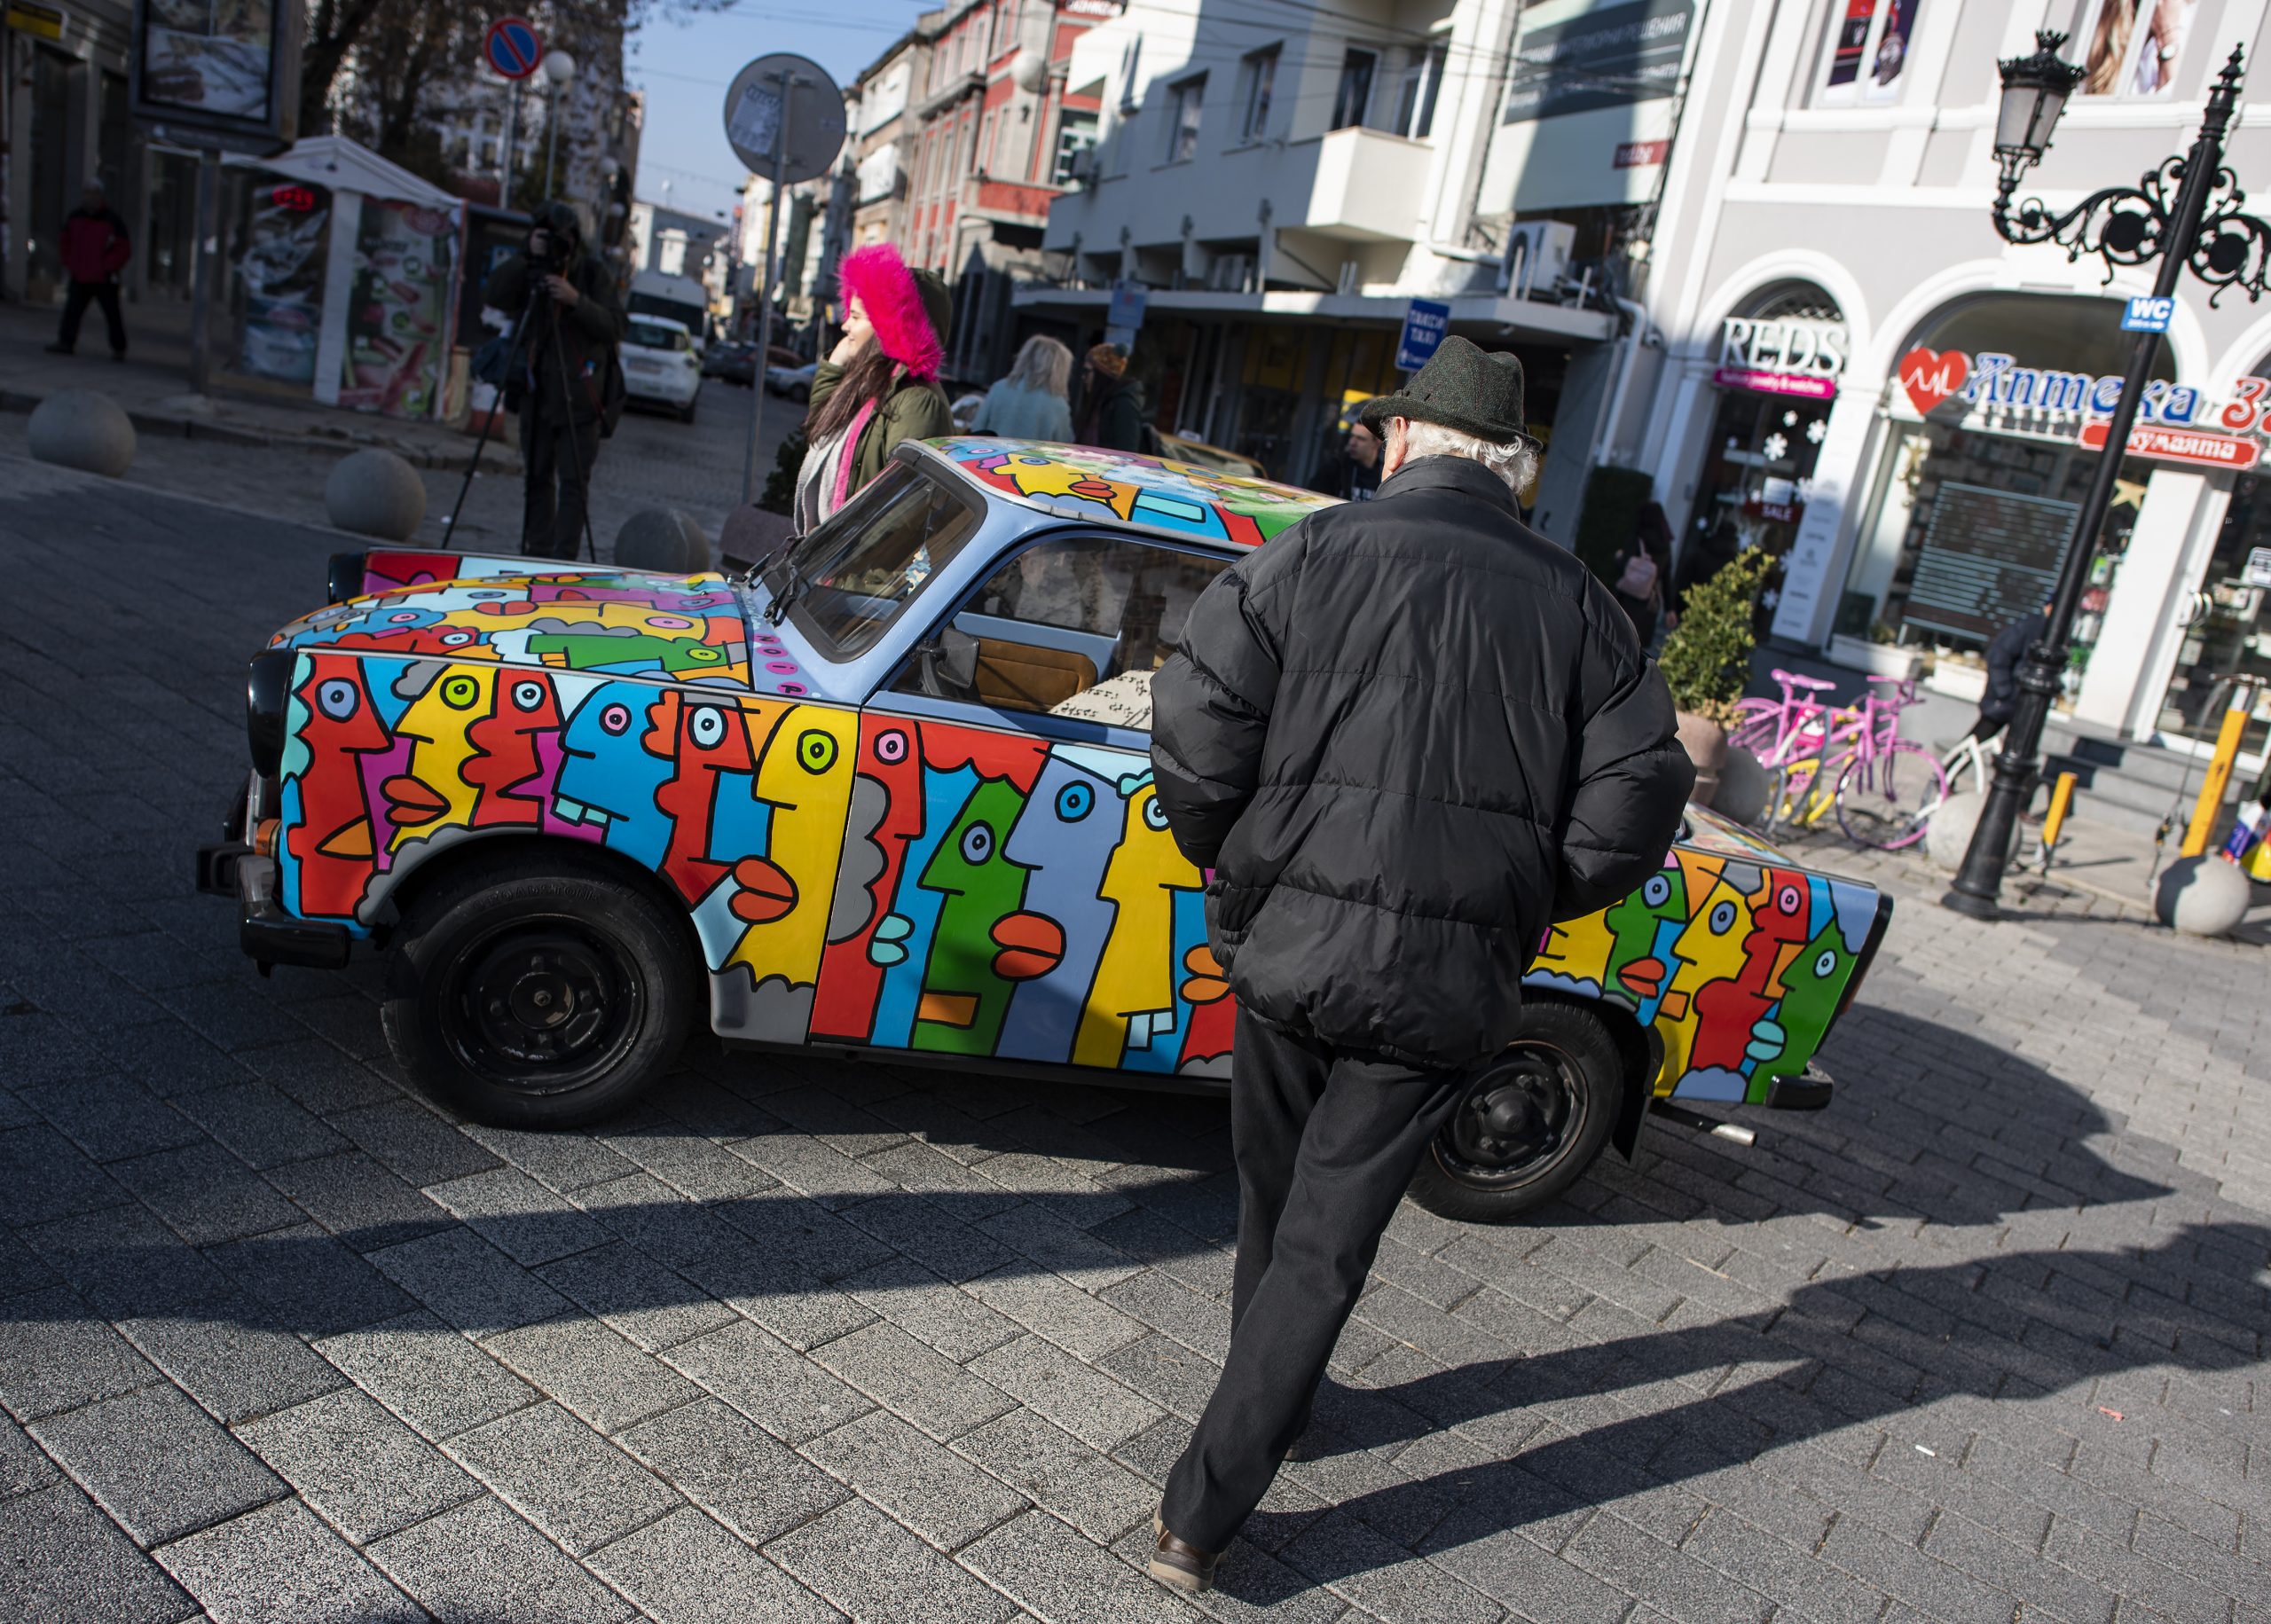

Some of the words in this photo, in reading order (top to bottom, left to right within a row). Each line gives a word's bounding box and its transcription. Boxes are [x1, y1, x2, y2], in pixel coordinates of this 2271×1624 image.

[1408, 309, 1446, 330] ТАКСИ
[2131, 298, 2172, 320] WC
[1411, 326, 1437, 345] TAXI
[1718, 318, 1847, 379] REDS
[1761, 502, 1792, 522] SALE
